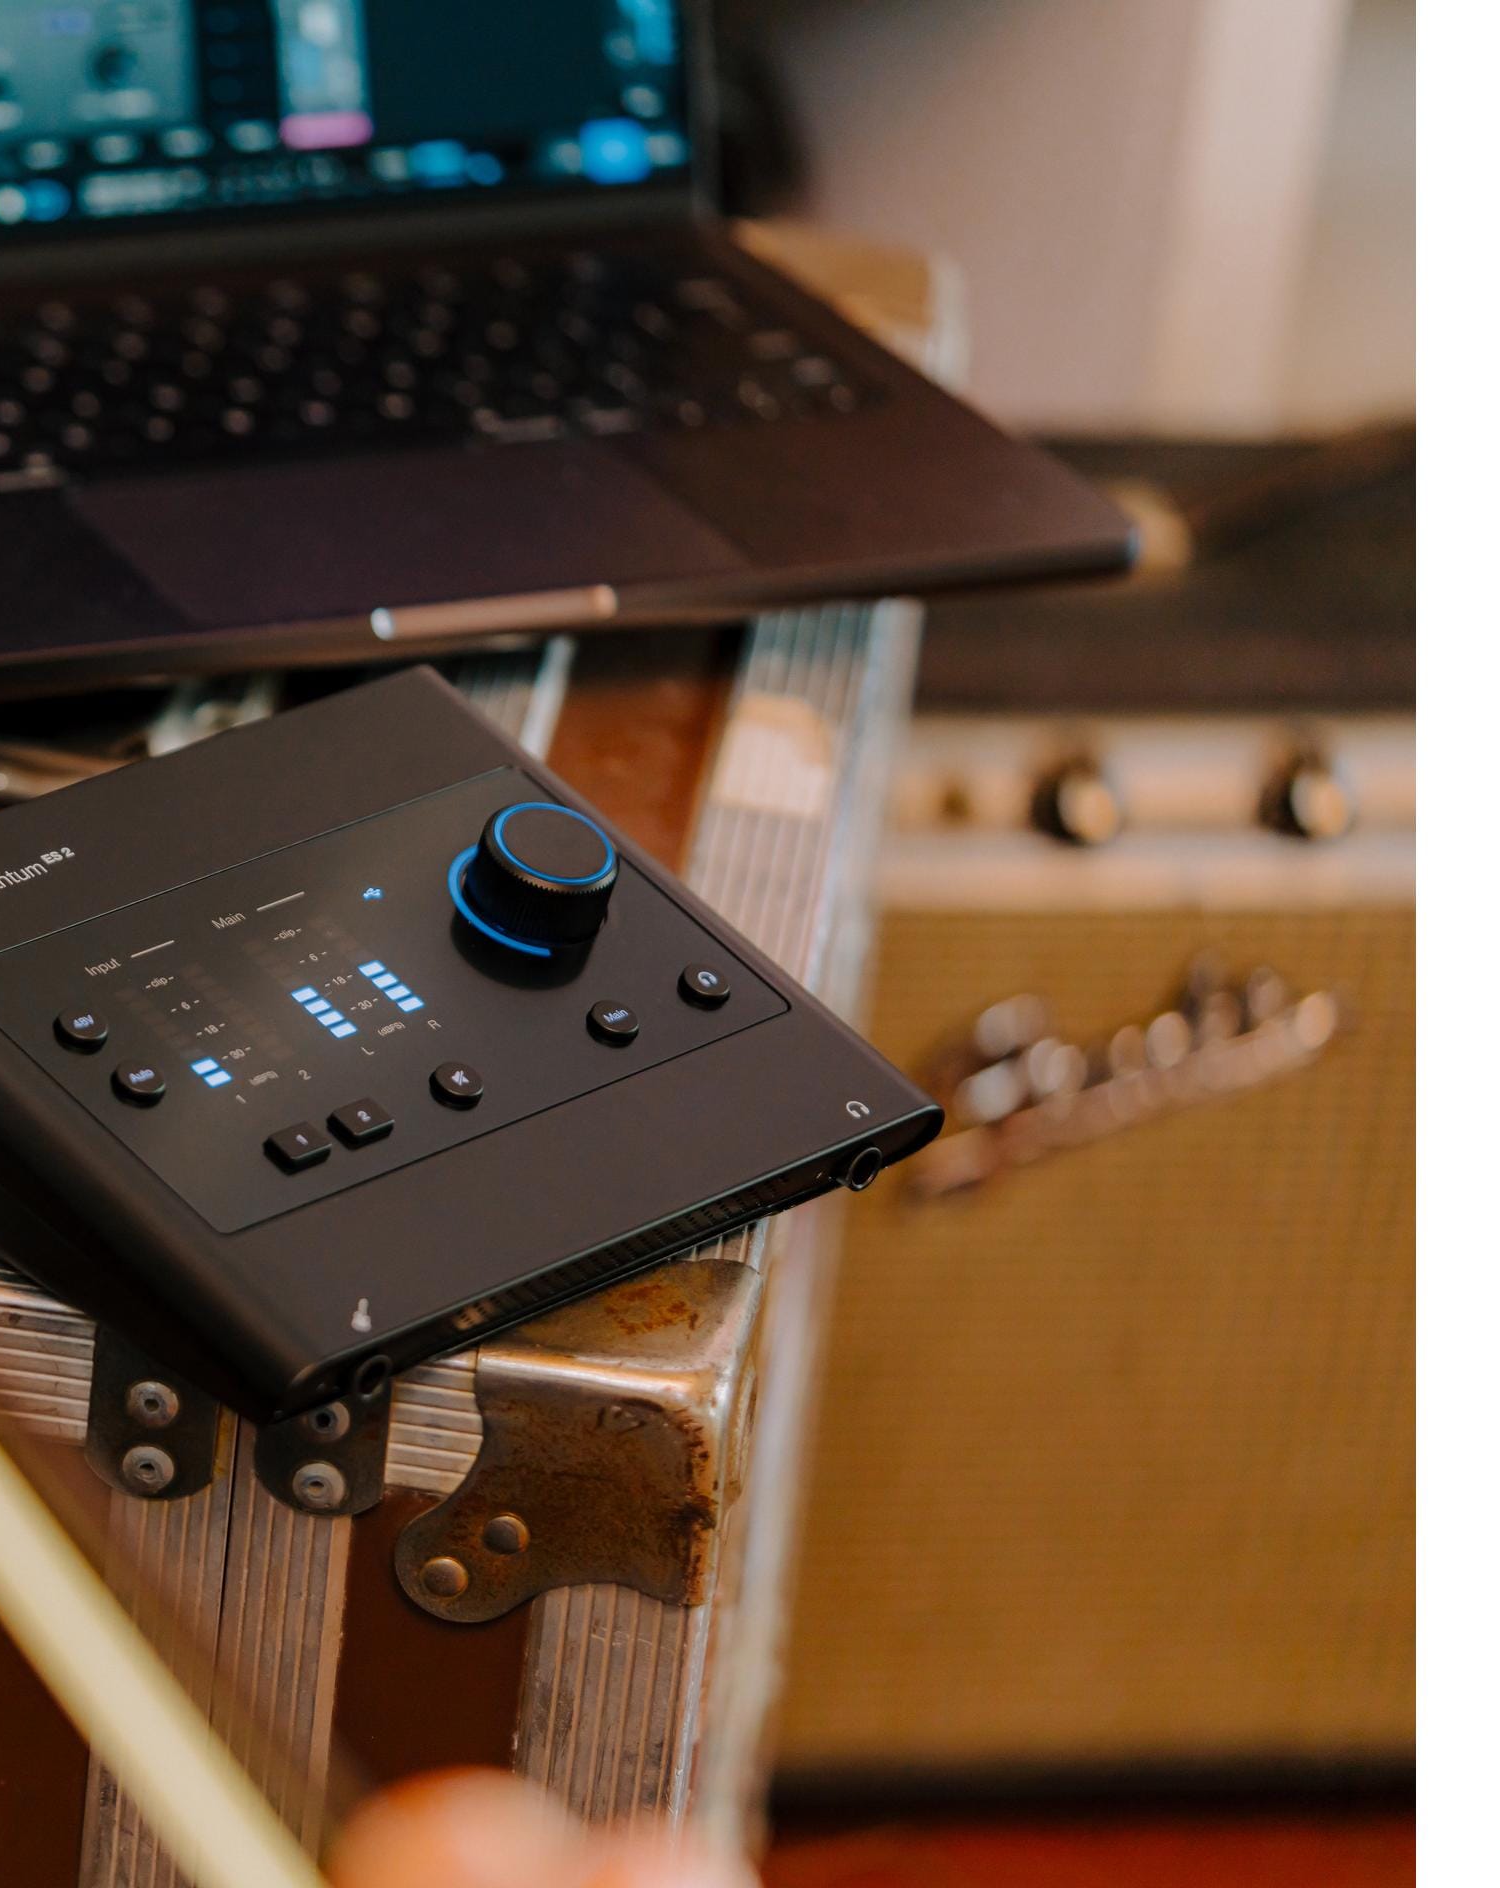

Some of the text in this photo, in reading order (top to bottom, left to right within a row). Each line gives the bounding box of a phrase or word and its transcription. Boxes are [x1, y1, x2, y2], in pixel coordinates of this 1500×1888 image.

[40, 851, 63, 865] ES
[61, 847, 76, 859] 2
[212, 911, 246, 929] Main
[85, 958, 122, 977] Input
[602, 1009, 629, 1024] Main
[427, 1018, 442, 1031] R
[360, 1046, 376, 1057] L
[128, 1068, 156, 1085] Auto
[298, 1069, 312, 1081] 2
[357, 1110, 372, 1123] 2
